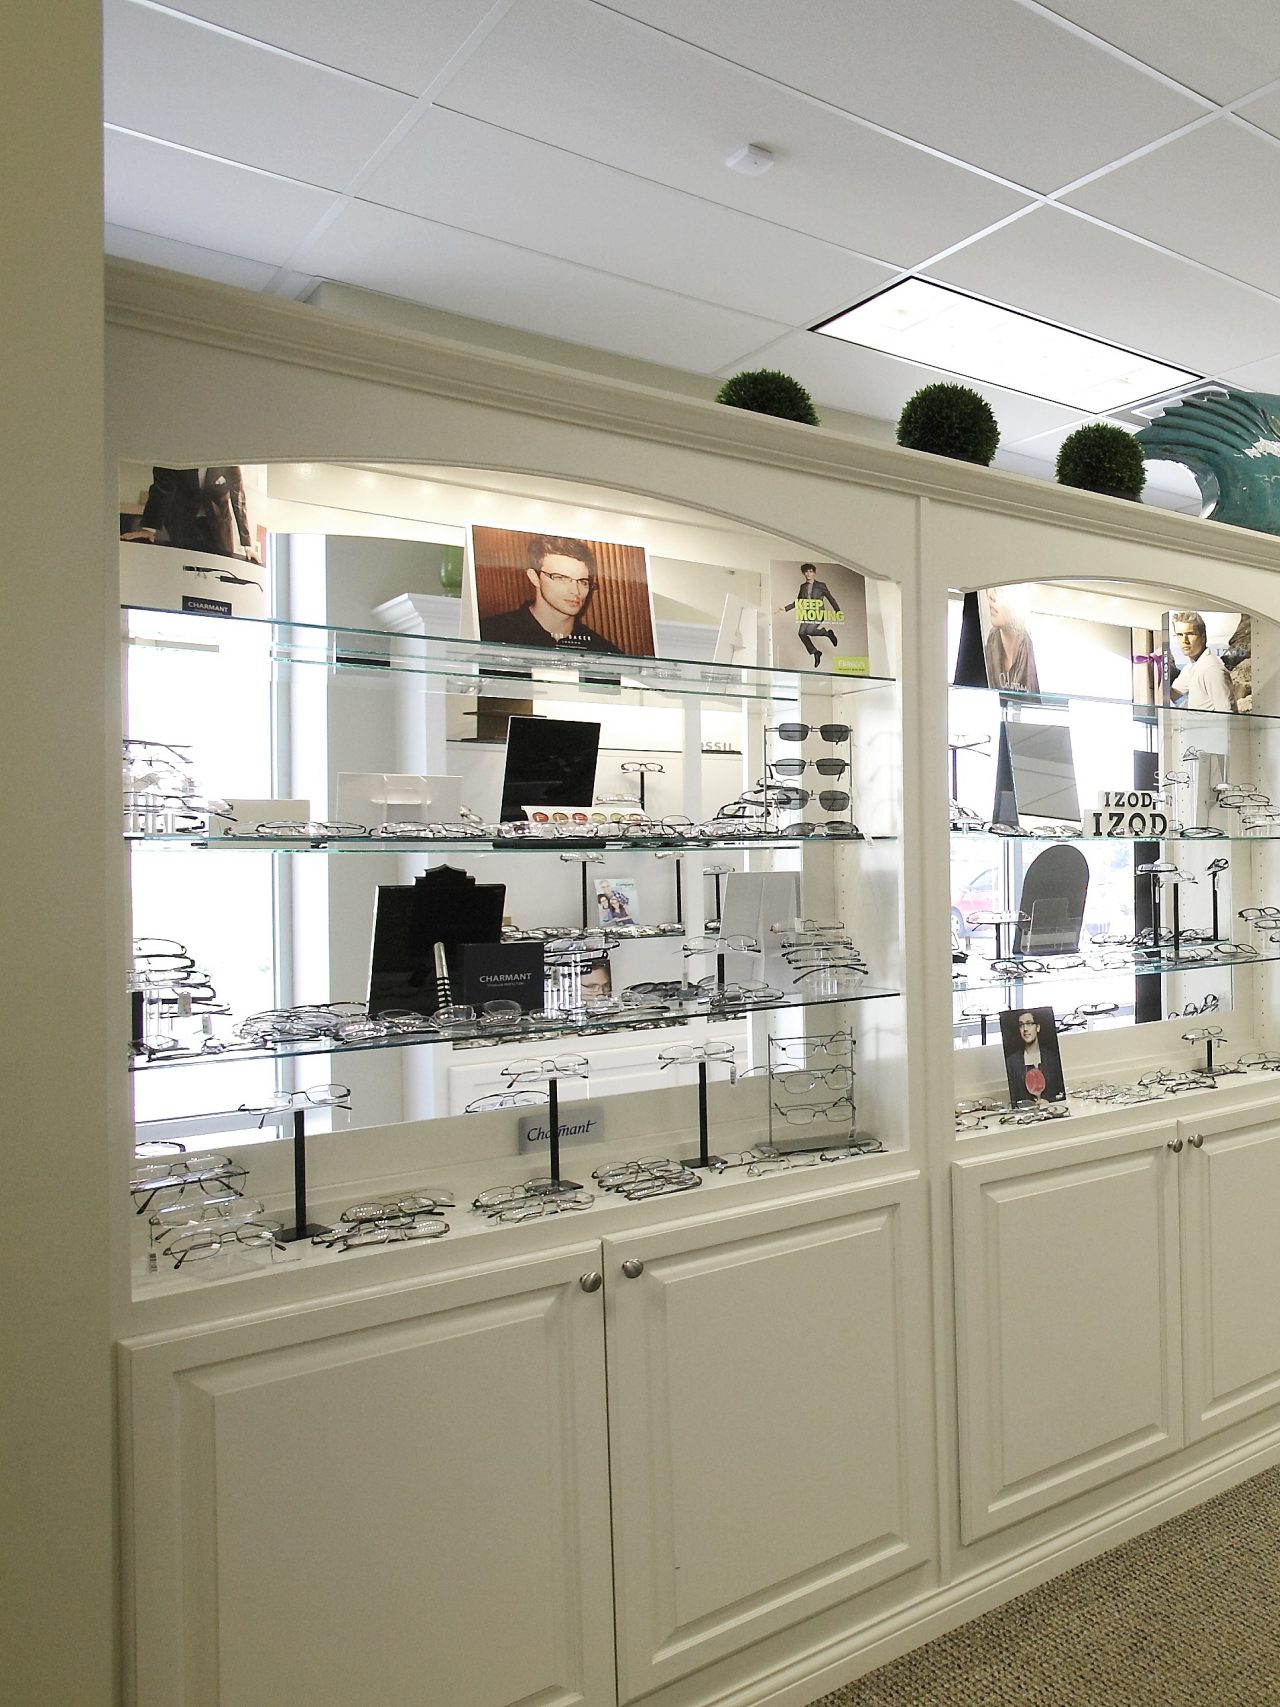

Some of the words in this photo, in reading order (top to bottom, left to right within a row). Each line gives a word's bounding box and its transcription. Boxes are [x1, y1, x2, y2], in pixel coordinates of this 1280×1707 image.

[187, 601, 229, 613] CHARMANT
[795, 599, 824, 610] KEEP
[796, 610, 845, 622] MOVING
[1104, 791, 1153, 808] IZOD
[1092, 812, 1168, 837] IZOD
[479, 973, 532, 983] CHARMANT
[527, 1120, 597, 1142] Chamant
